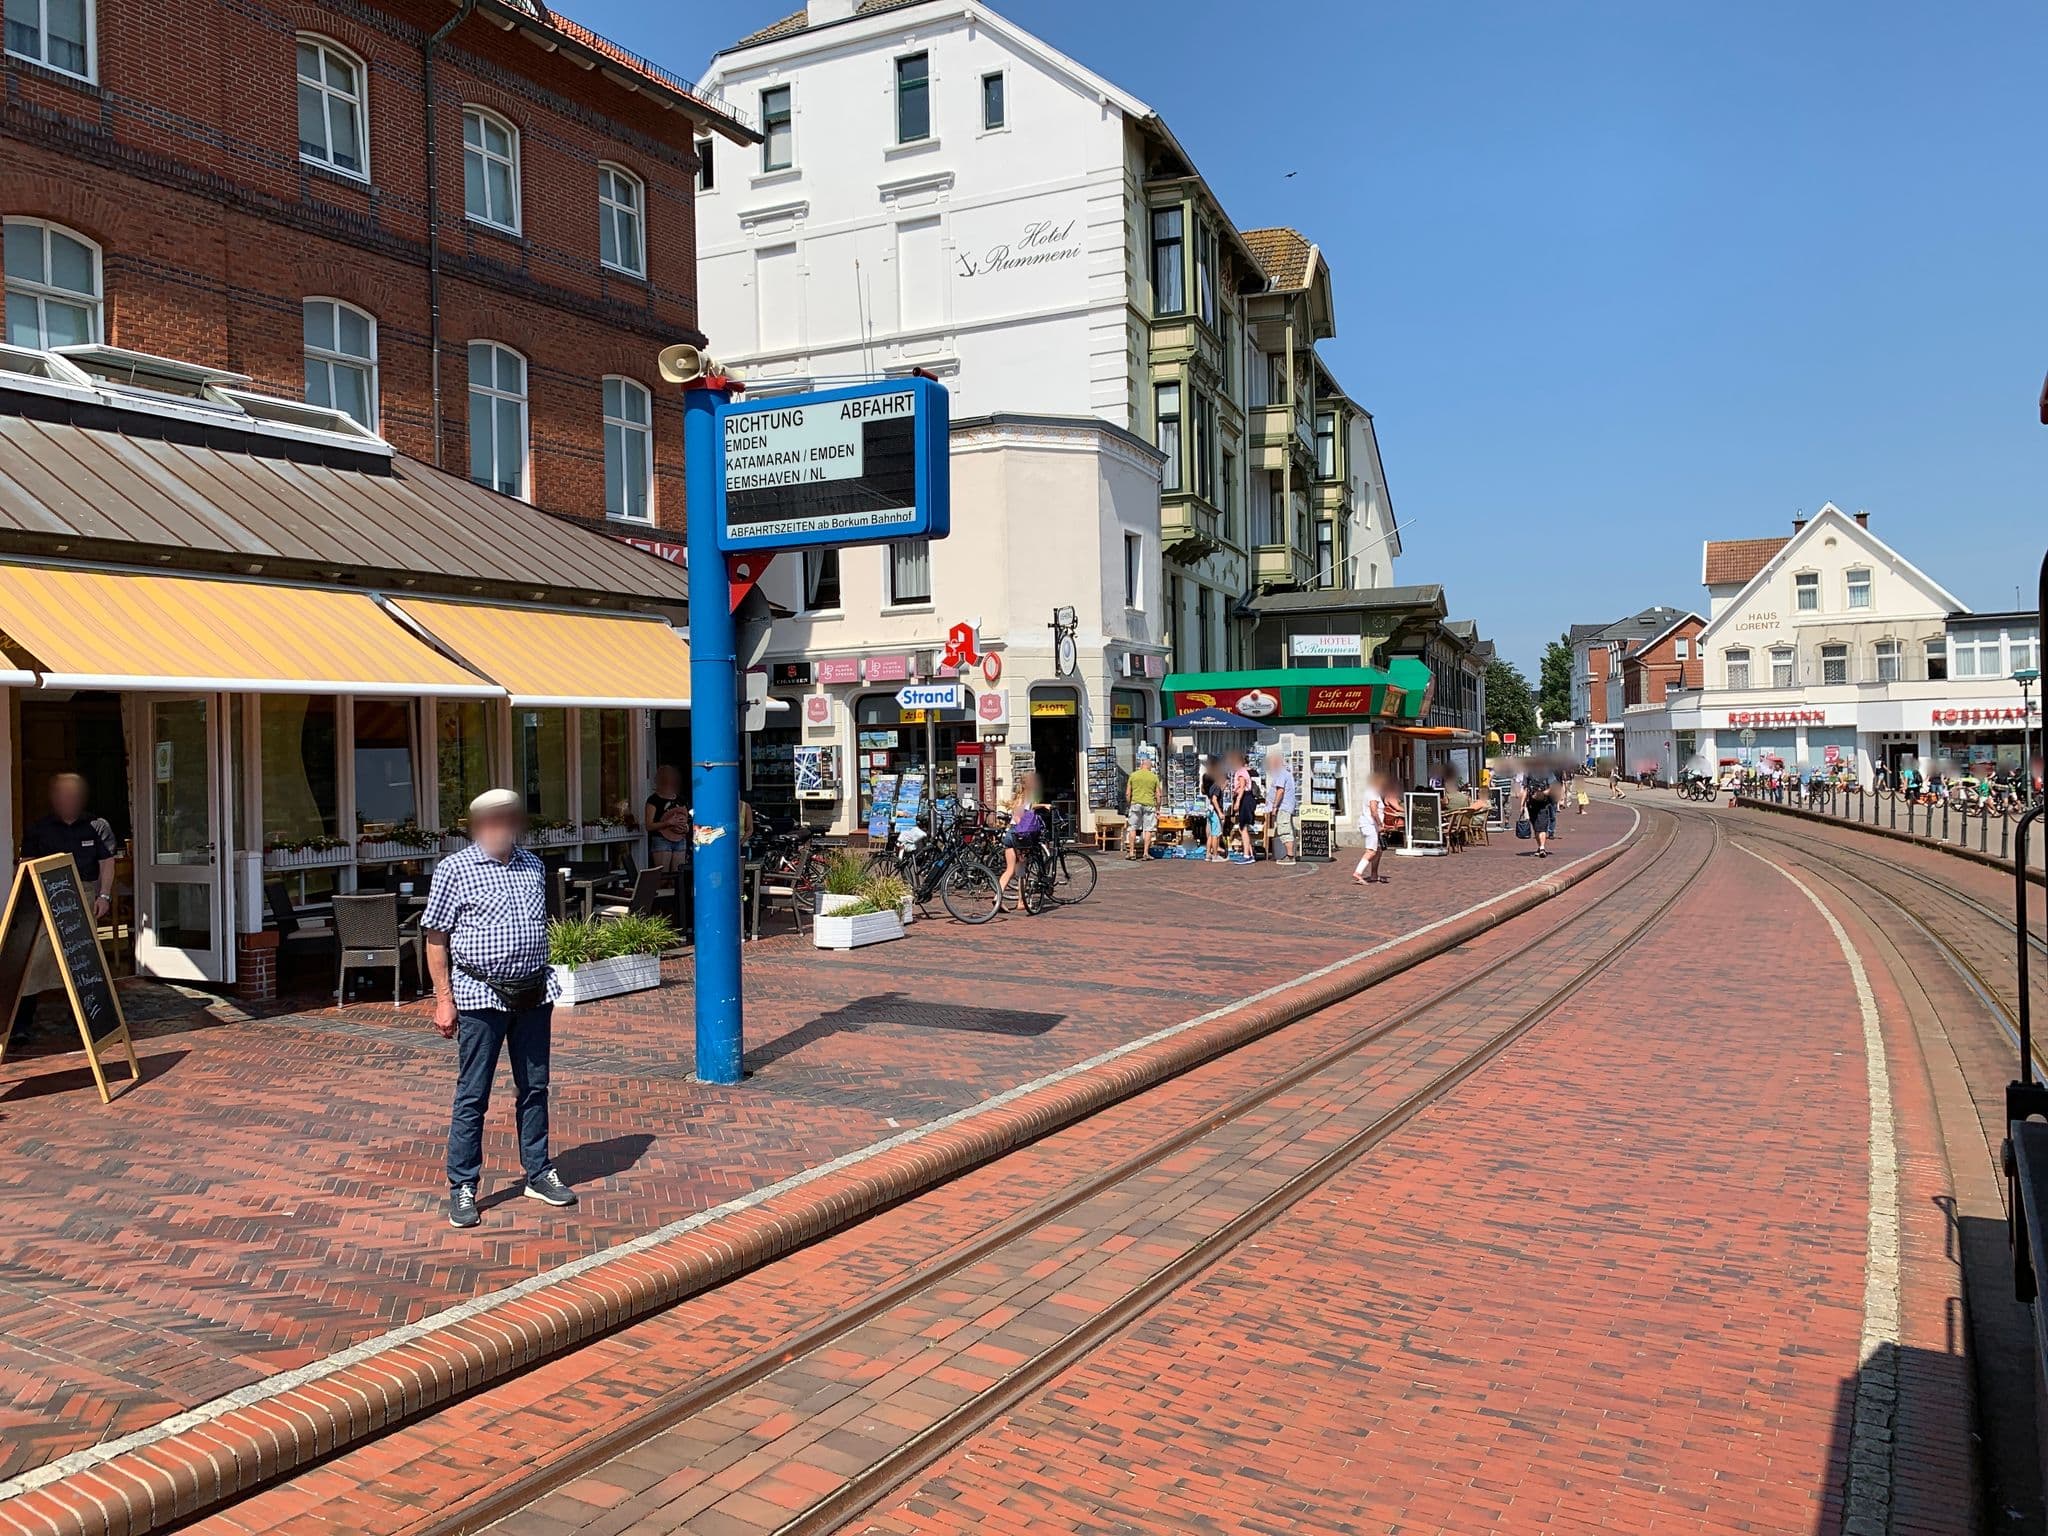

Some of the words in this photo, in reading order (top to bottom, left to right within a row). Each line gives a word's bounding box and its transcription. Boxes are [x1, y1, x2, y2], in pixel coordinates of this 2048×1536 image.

[1018, 220, 1076, 249] Hotel
[978, 242, 1082, 274] Rummeni
[840, 394, 914, 420] ABFAHRT
[725, 410, 804, 434] RICHTUNG
[725, 435, 767, 452] EMDEN
[726, 451, 800, 471] KATAMARAN
[810, 444, 855, 460] EMDEN
[726, 471, 800, 490] EEMSHAVEN
[810, 467, 827, 480] NL
[731, 521, 816, 538] ABFAHRTSZEITEN
[817, 519, 830, 529] ab
[831, 515, 869, 528] Borkum
[871, 511, 912, 525] Bahnhof
[1748, 611, 1777, 620] HAUS
[1736, 621, 1780, 631] LORENTZ
[1320, 637, 1354, 645] HOTEL
[903, 688, 954, 704] Strand
[1318, 689, 1341, 700] Cafe
[1345, 690, 1362, 698] am
[1315, 699, 1363, 711] Bahnhof
[1728, 710, 1826, 723] ROSSMANN
[1301, 808, 1329, 816] CAMEL
